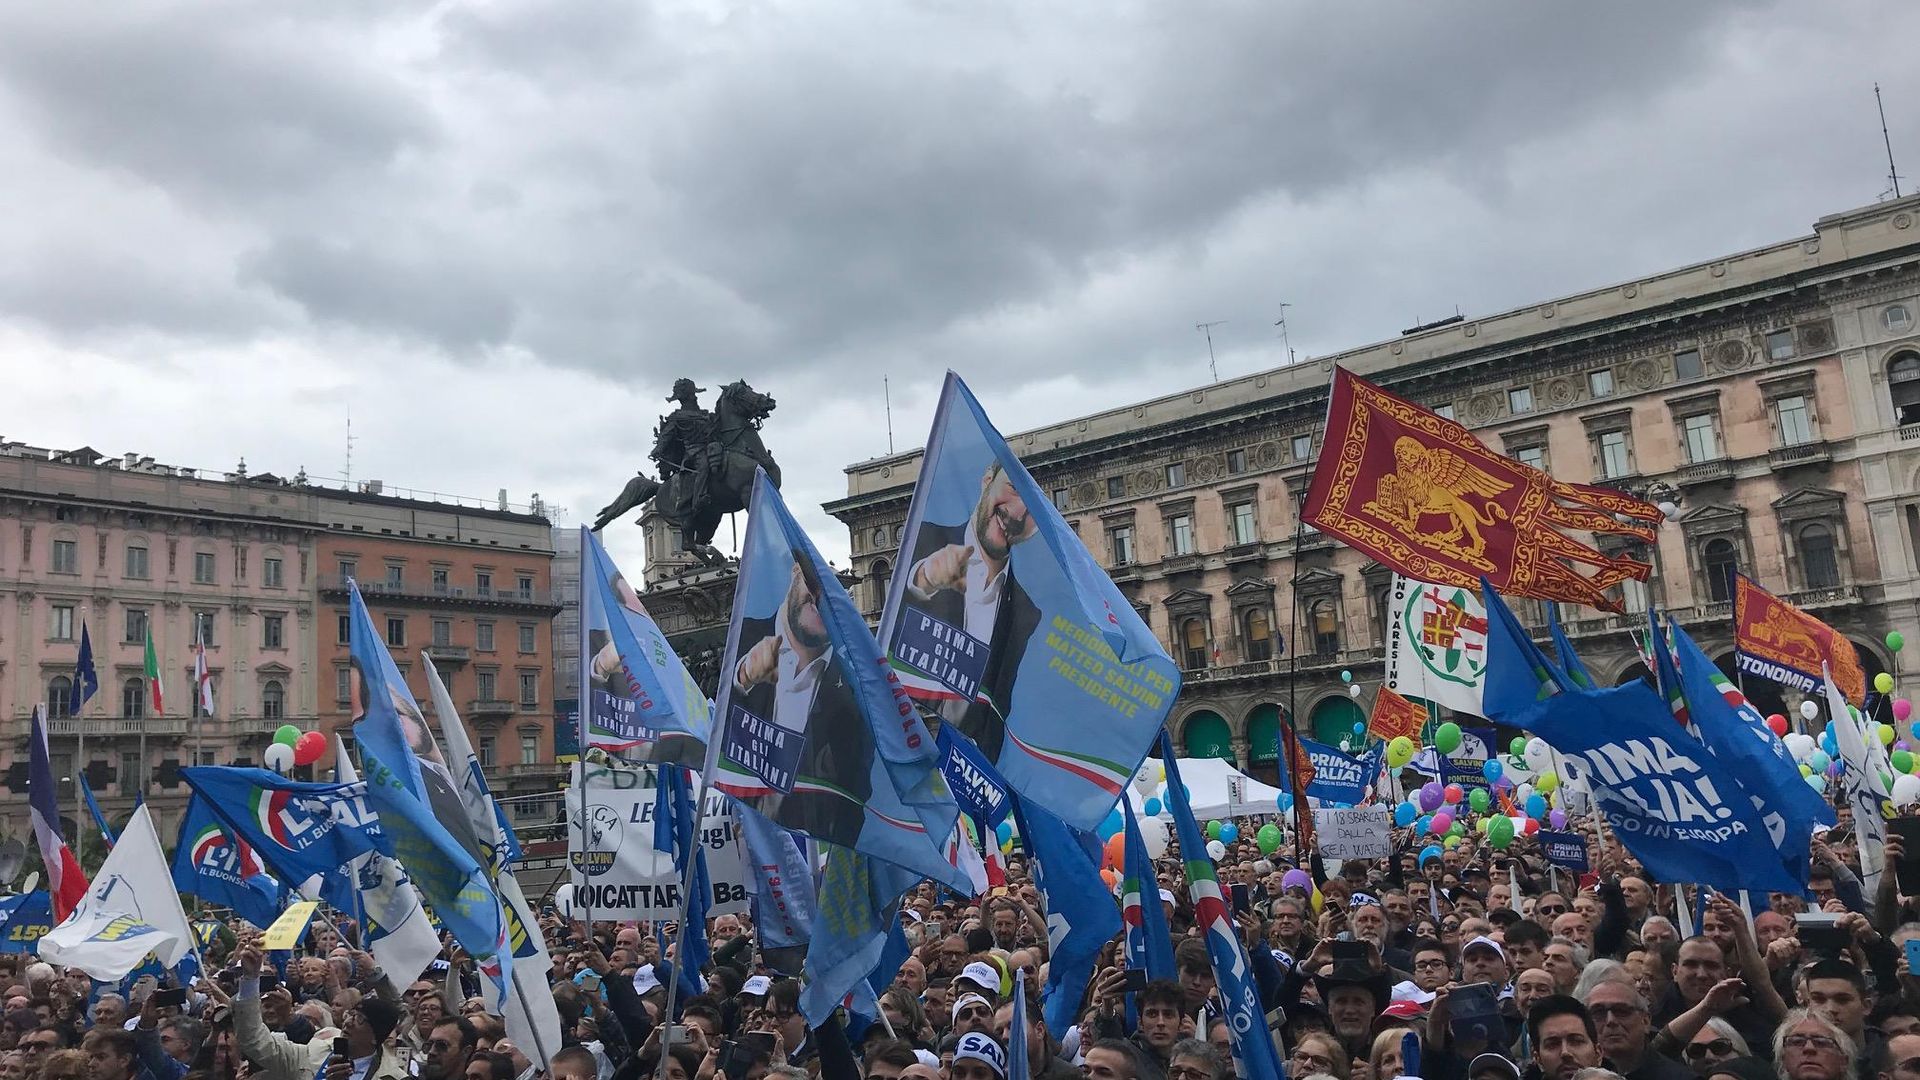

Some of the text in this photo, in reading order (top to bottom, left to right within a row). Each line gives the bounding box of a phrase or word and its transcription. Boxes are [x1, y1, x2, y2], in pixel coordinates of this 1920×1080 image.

[920, 616, 975, 658] PRIMA
[934, 643, 956, 663] GLI
[1389, 611, 1401, 689] VARESINO
[899, 643, 975, 696] ITALIANI
[1048, 655, 1139, 719] PRESIDENTE
[1105, 668, 1164, 710] SALVINI
[605, 693, 636, 713] PRIM
[597, 714, 654, 739] ITALIANI
[741, 713, 785, 749] PRIMA
[751, 739, 769, 757] GLI
[729, 741, 789, 788] ITALIANI
[1310, 753, 1363, 775] PRIMA
[951, 749, 1003, 808] SALVINI
[1334, 811, 1345, 825] 18
[1337, 828, 1376, 840] DALLA
[1673, 820, 1748, 843] EUROPA
[1320, 843, 1348, 859] SEA
[1554, 843, 1581, 851] PRIMA
